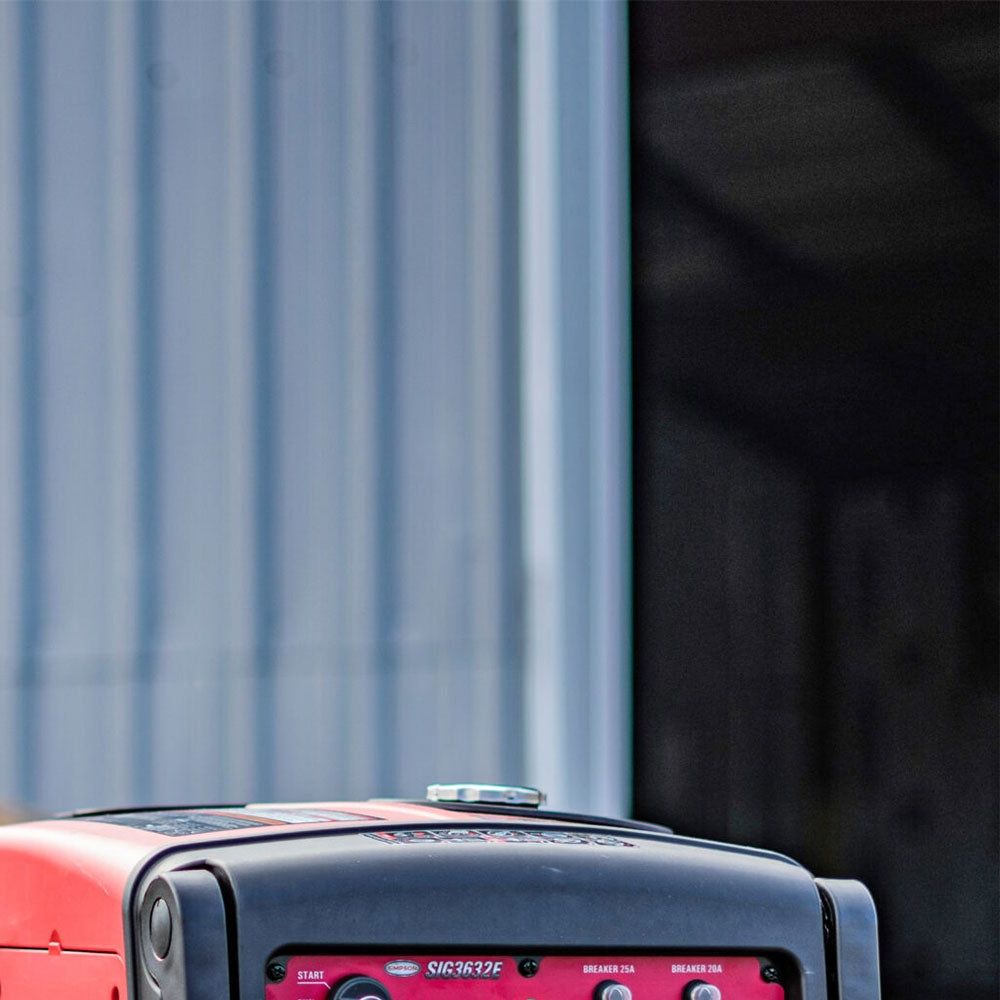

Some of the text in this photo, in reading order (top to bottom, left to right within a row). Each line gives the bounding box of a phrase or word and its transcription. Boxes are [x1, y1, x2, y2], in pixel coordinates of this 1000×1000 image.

[425, 961, 503, 980] SIG3632E
[583, 965, 635, 974] BREAKER 25A
[671, 964, 722, 973] BREAKER 20A
[297, 971, 324, 980] START
